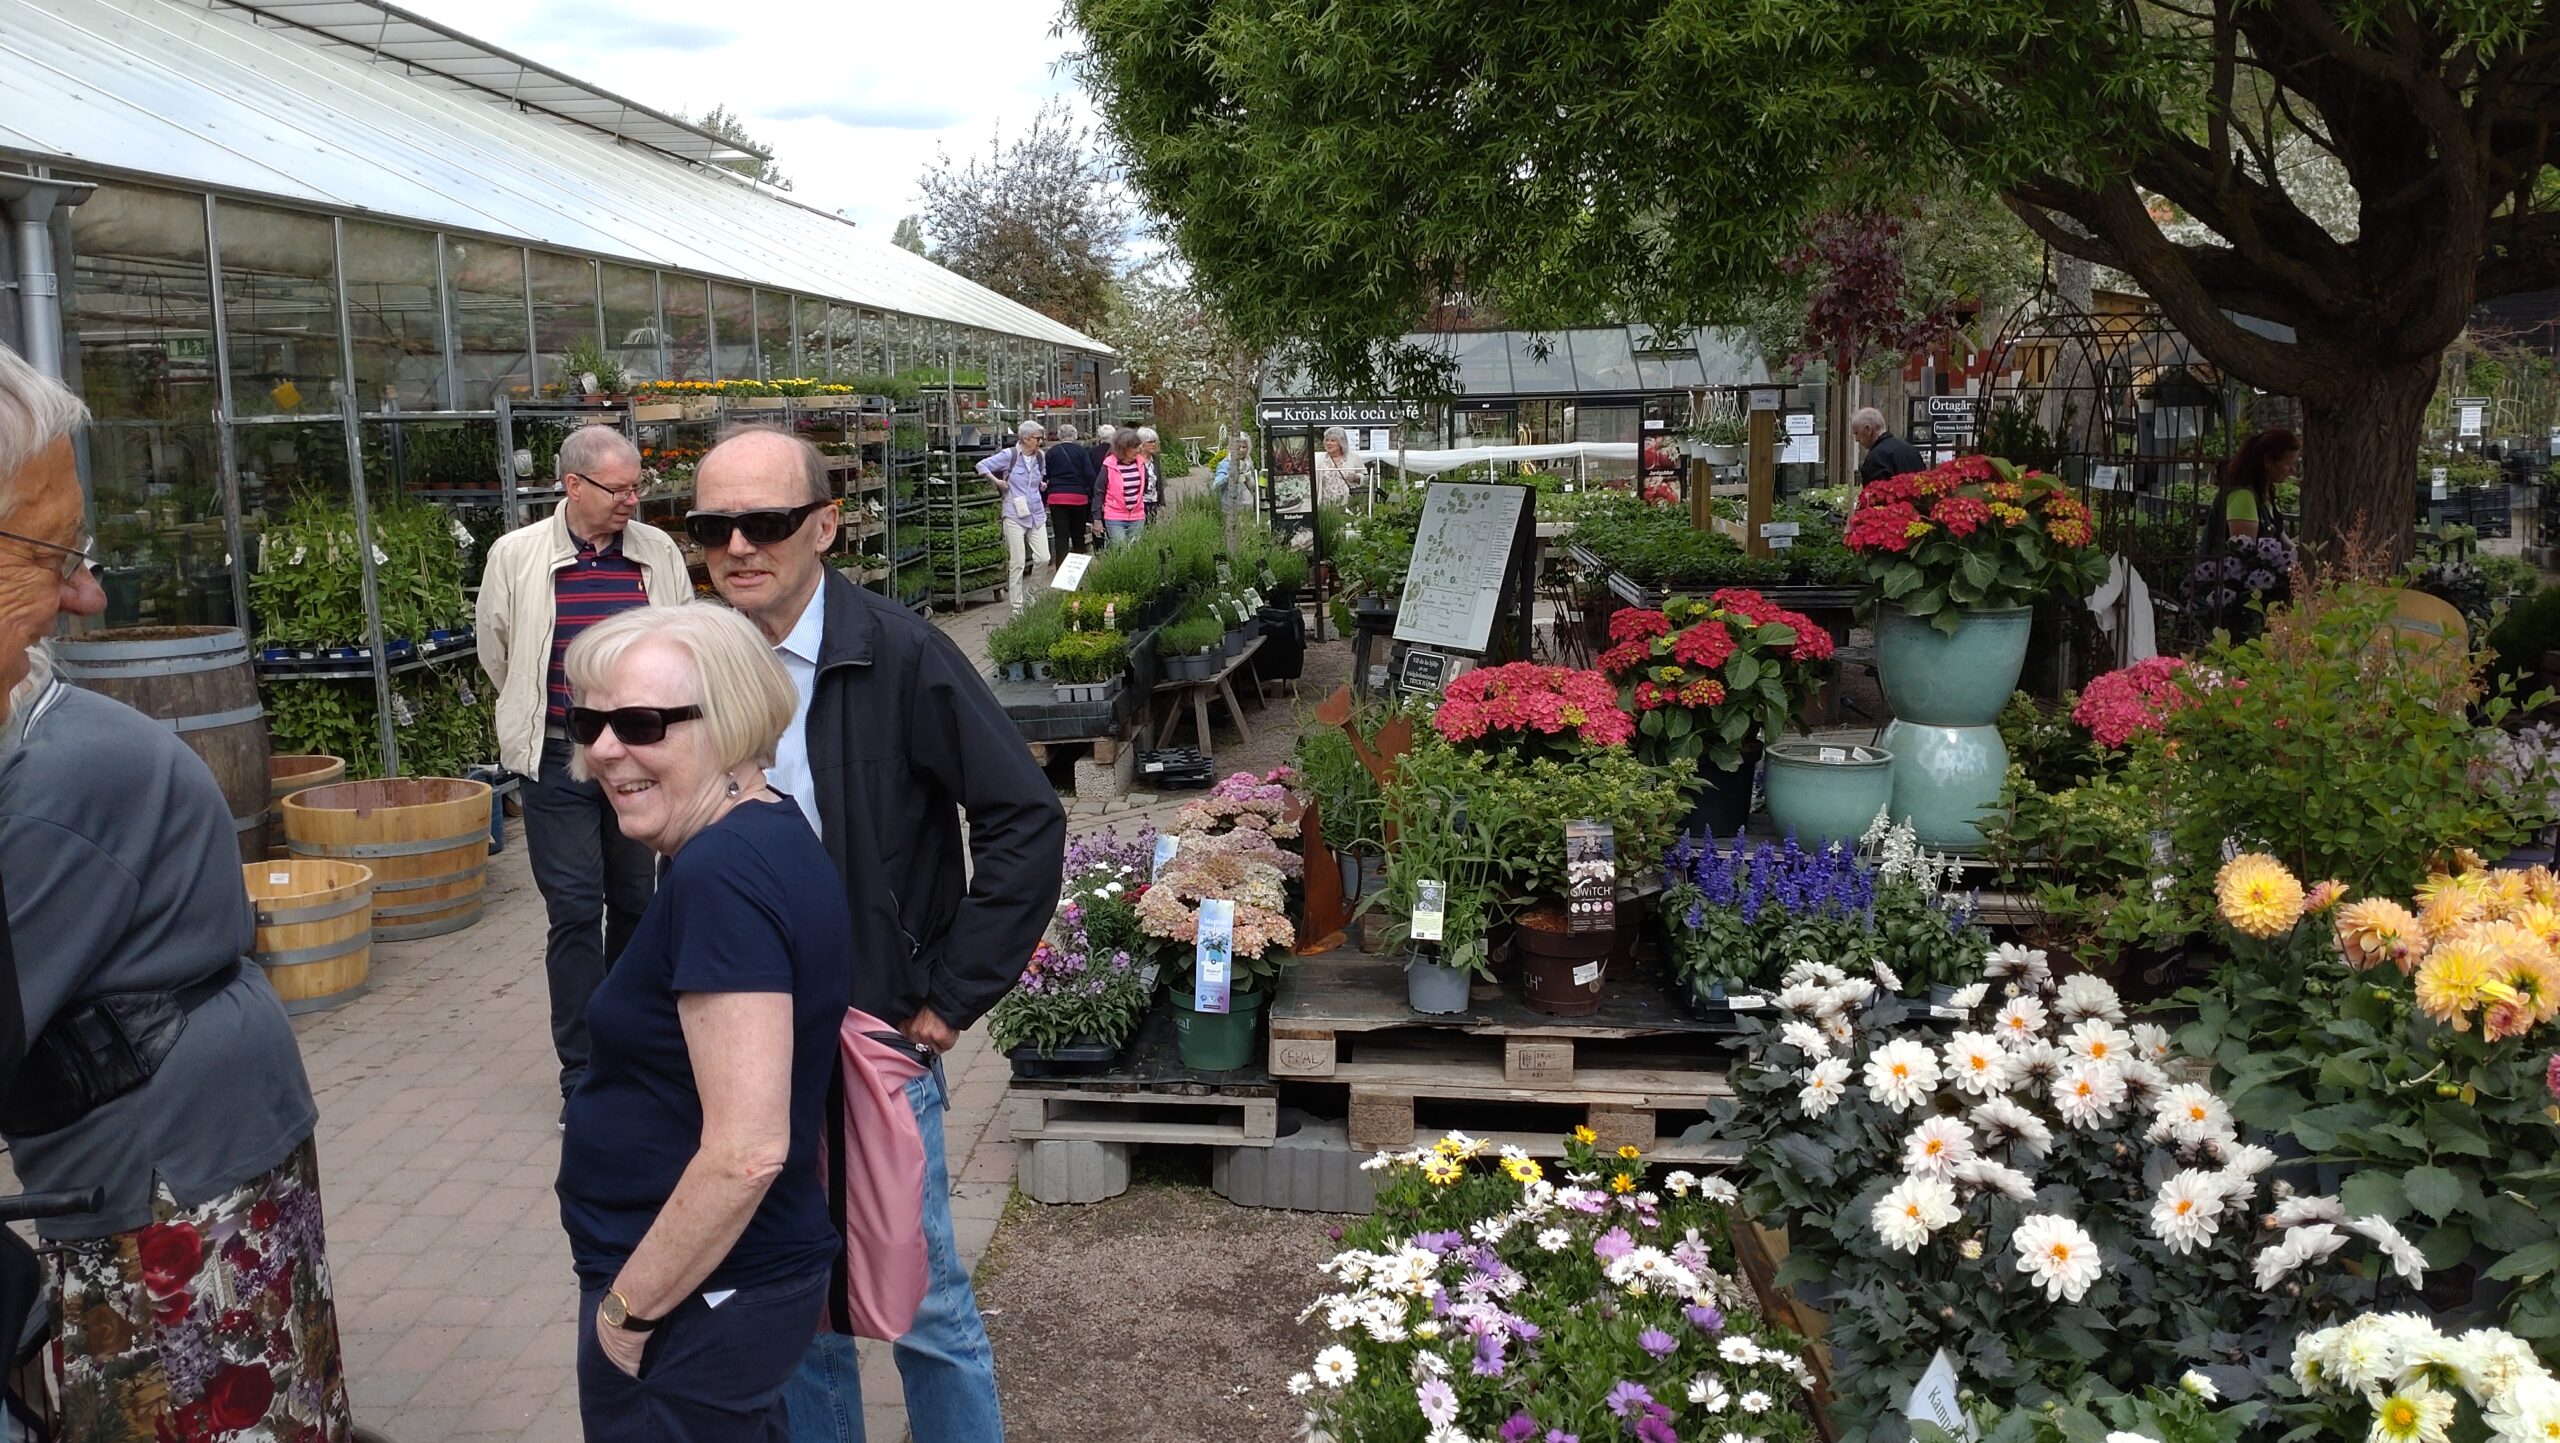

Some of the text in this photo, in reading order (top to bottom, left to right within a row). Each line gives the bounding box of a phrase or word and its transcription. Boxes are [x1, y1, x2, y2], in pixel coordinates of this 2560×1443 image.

[1932, 398, 1979, 412] Örtagår
[1284, 406, 1327, 421] Kröns
[1330, 405, 1357, 420] kök
[1360, 405, 1386, 420] och
[1288, 1050, 1318, 1064] EPAL
